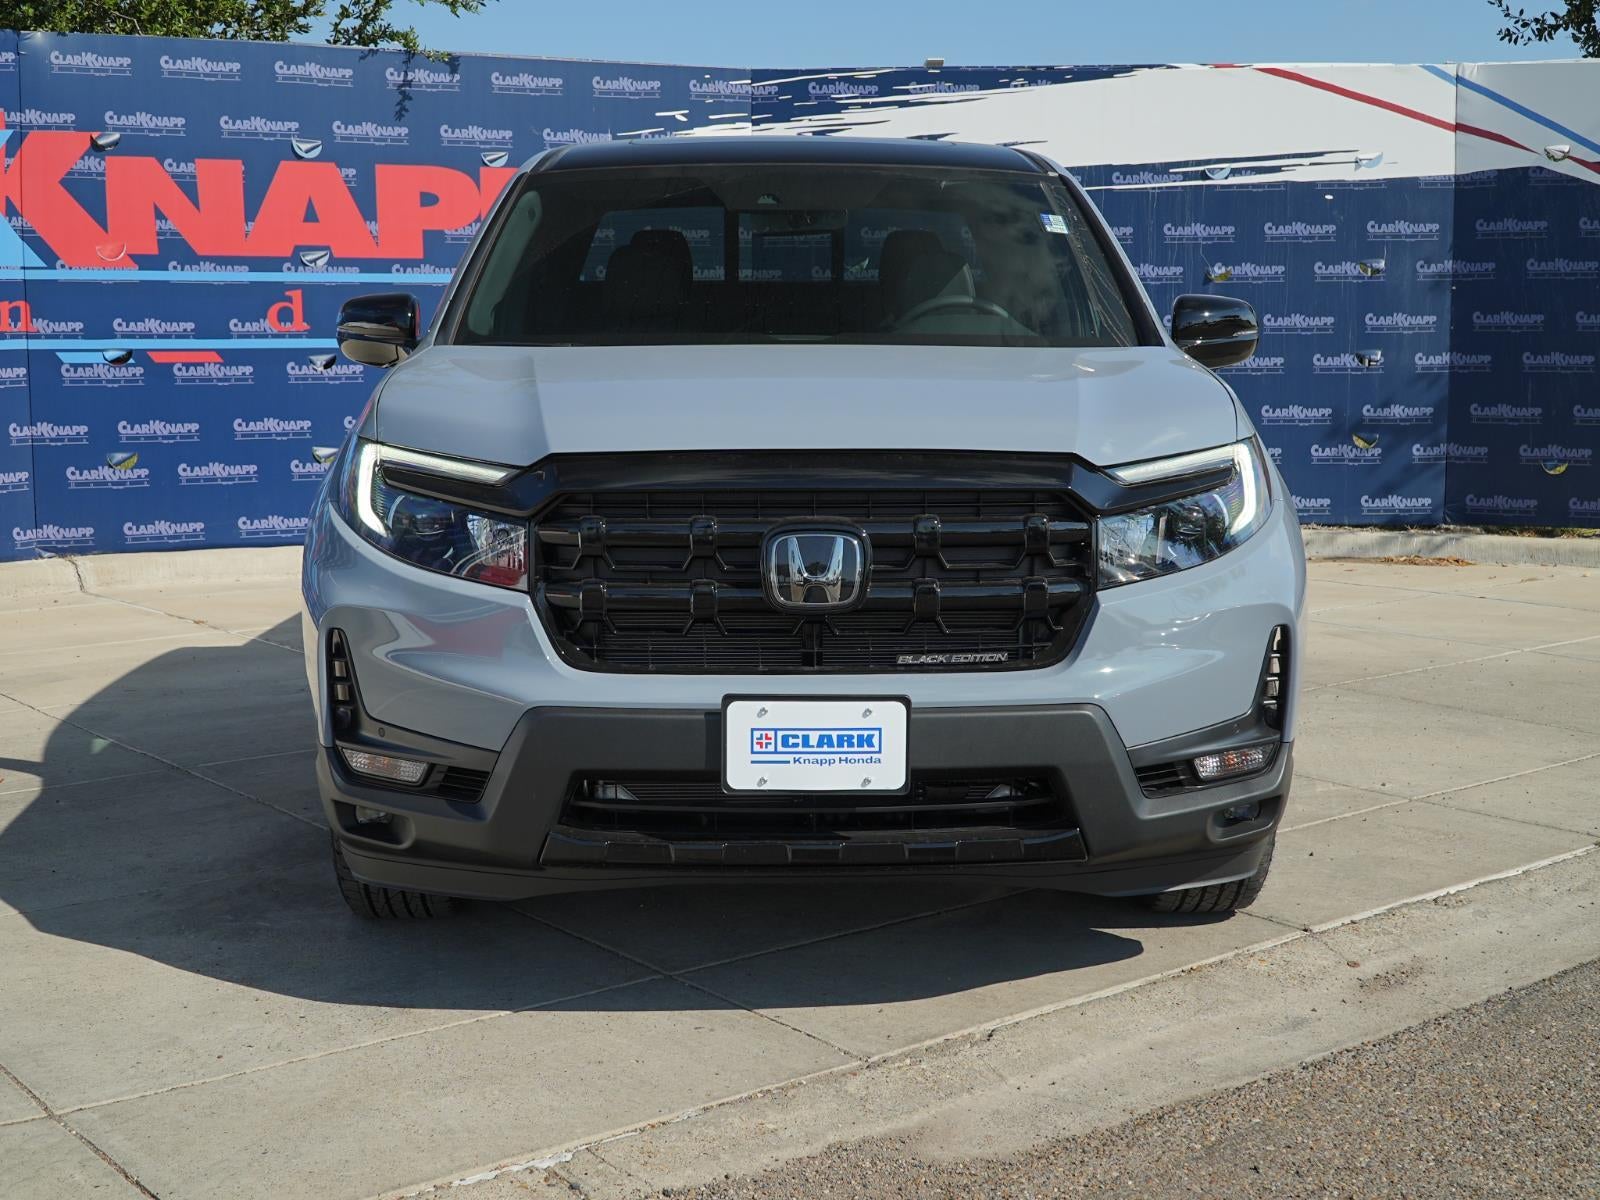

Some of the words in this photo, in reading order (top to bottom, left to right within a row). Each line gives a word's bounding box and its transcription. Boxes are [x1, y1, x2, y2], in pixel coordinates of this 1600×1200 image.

[897, 654, 949, 664] BLACK
[951, 652, 1008, 663] EDITION
[781, 733, 876, 749] CLARK
[792, 756, 836, 766] Knapp
[838, 755, 881, 765] Honda
